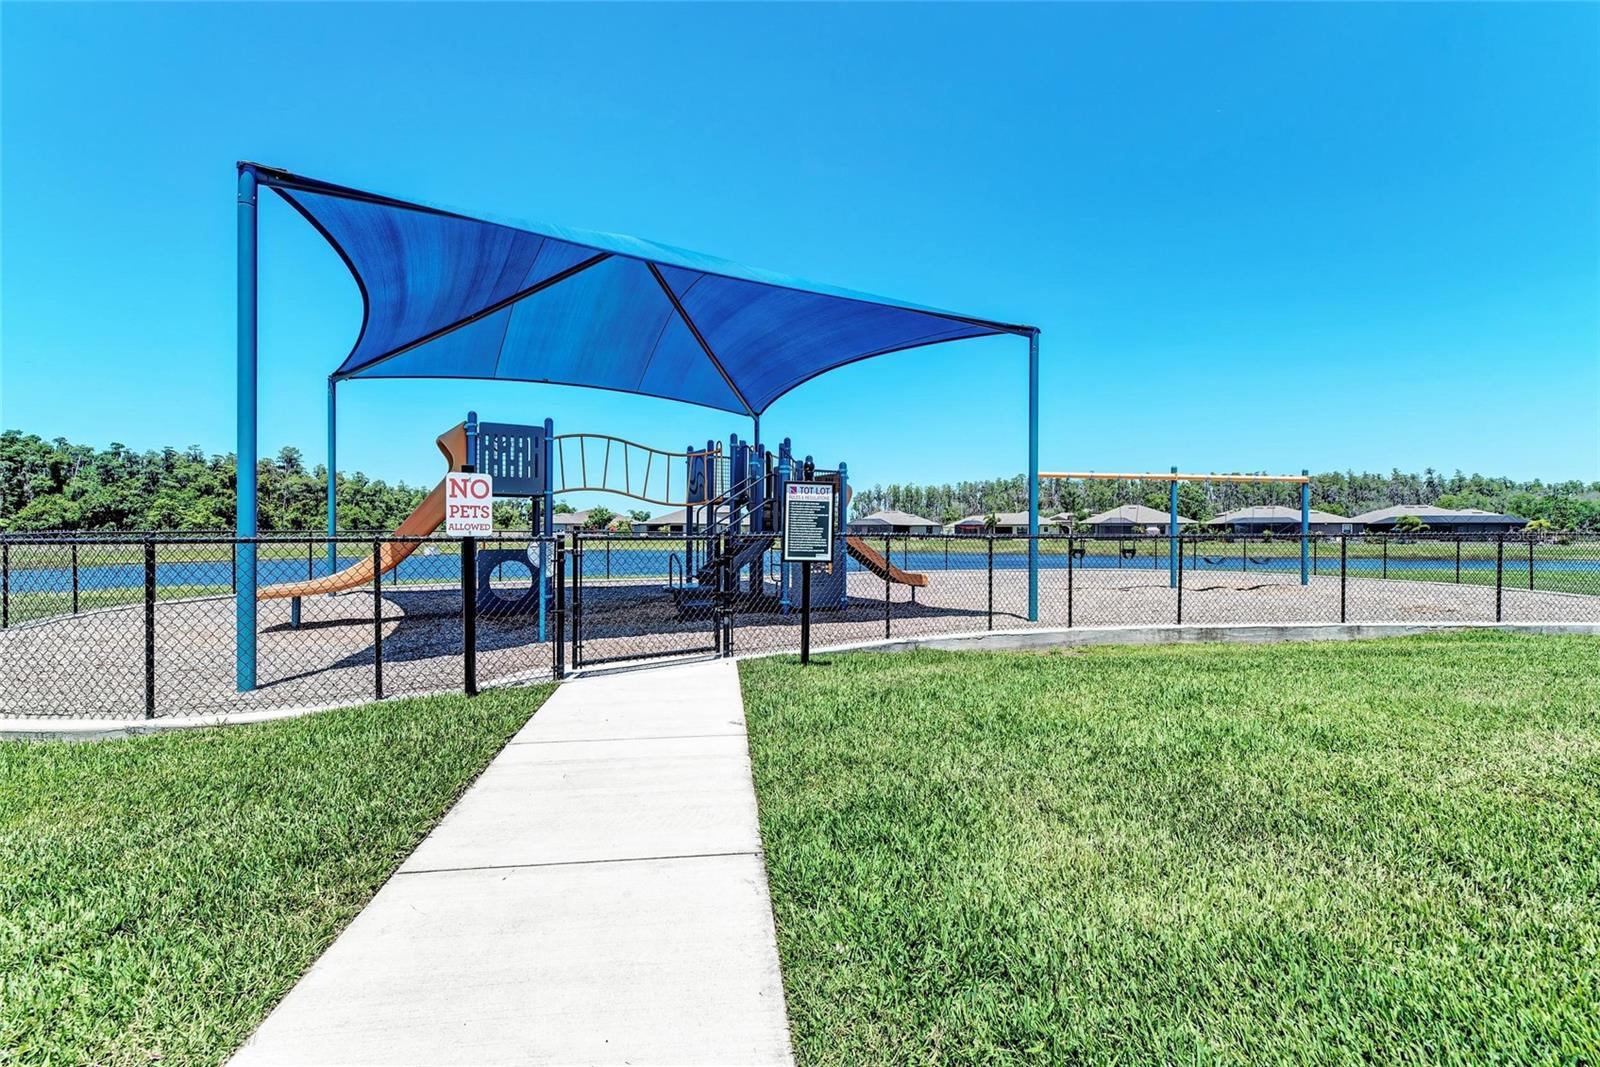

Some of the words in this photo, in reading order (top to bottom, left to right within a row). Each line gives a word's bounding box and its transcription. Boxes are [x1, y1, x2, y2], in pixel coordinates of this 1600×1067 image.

[449, 478, 489, 499] NO
[816, 487, 830, 495] LOT
[449, 505, 489, 518] PETS
